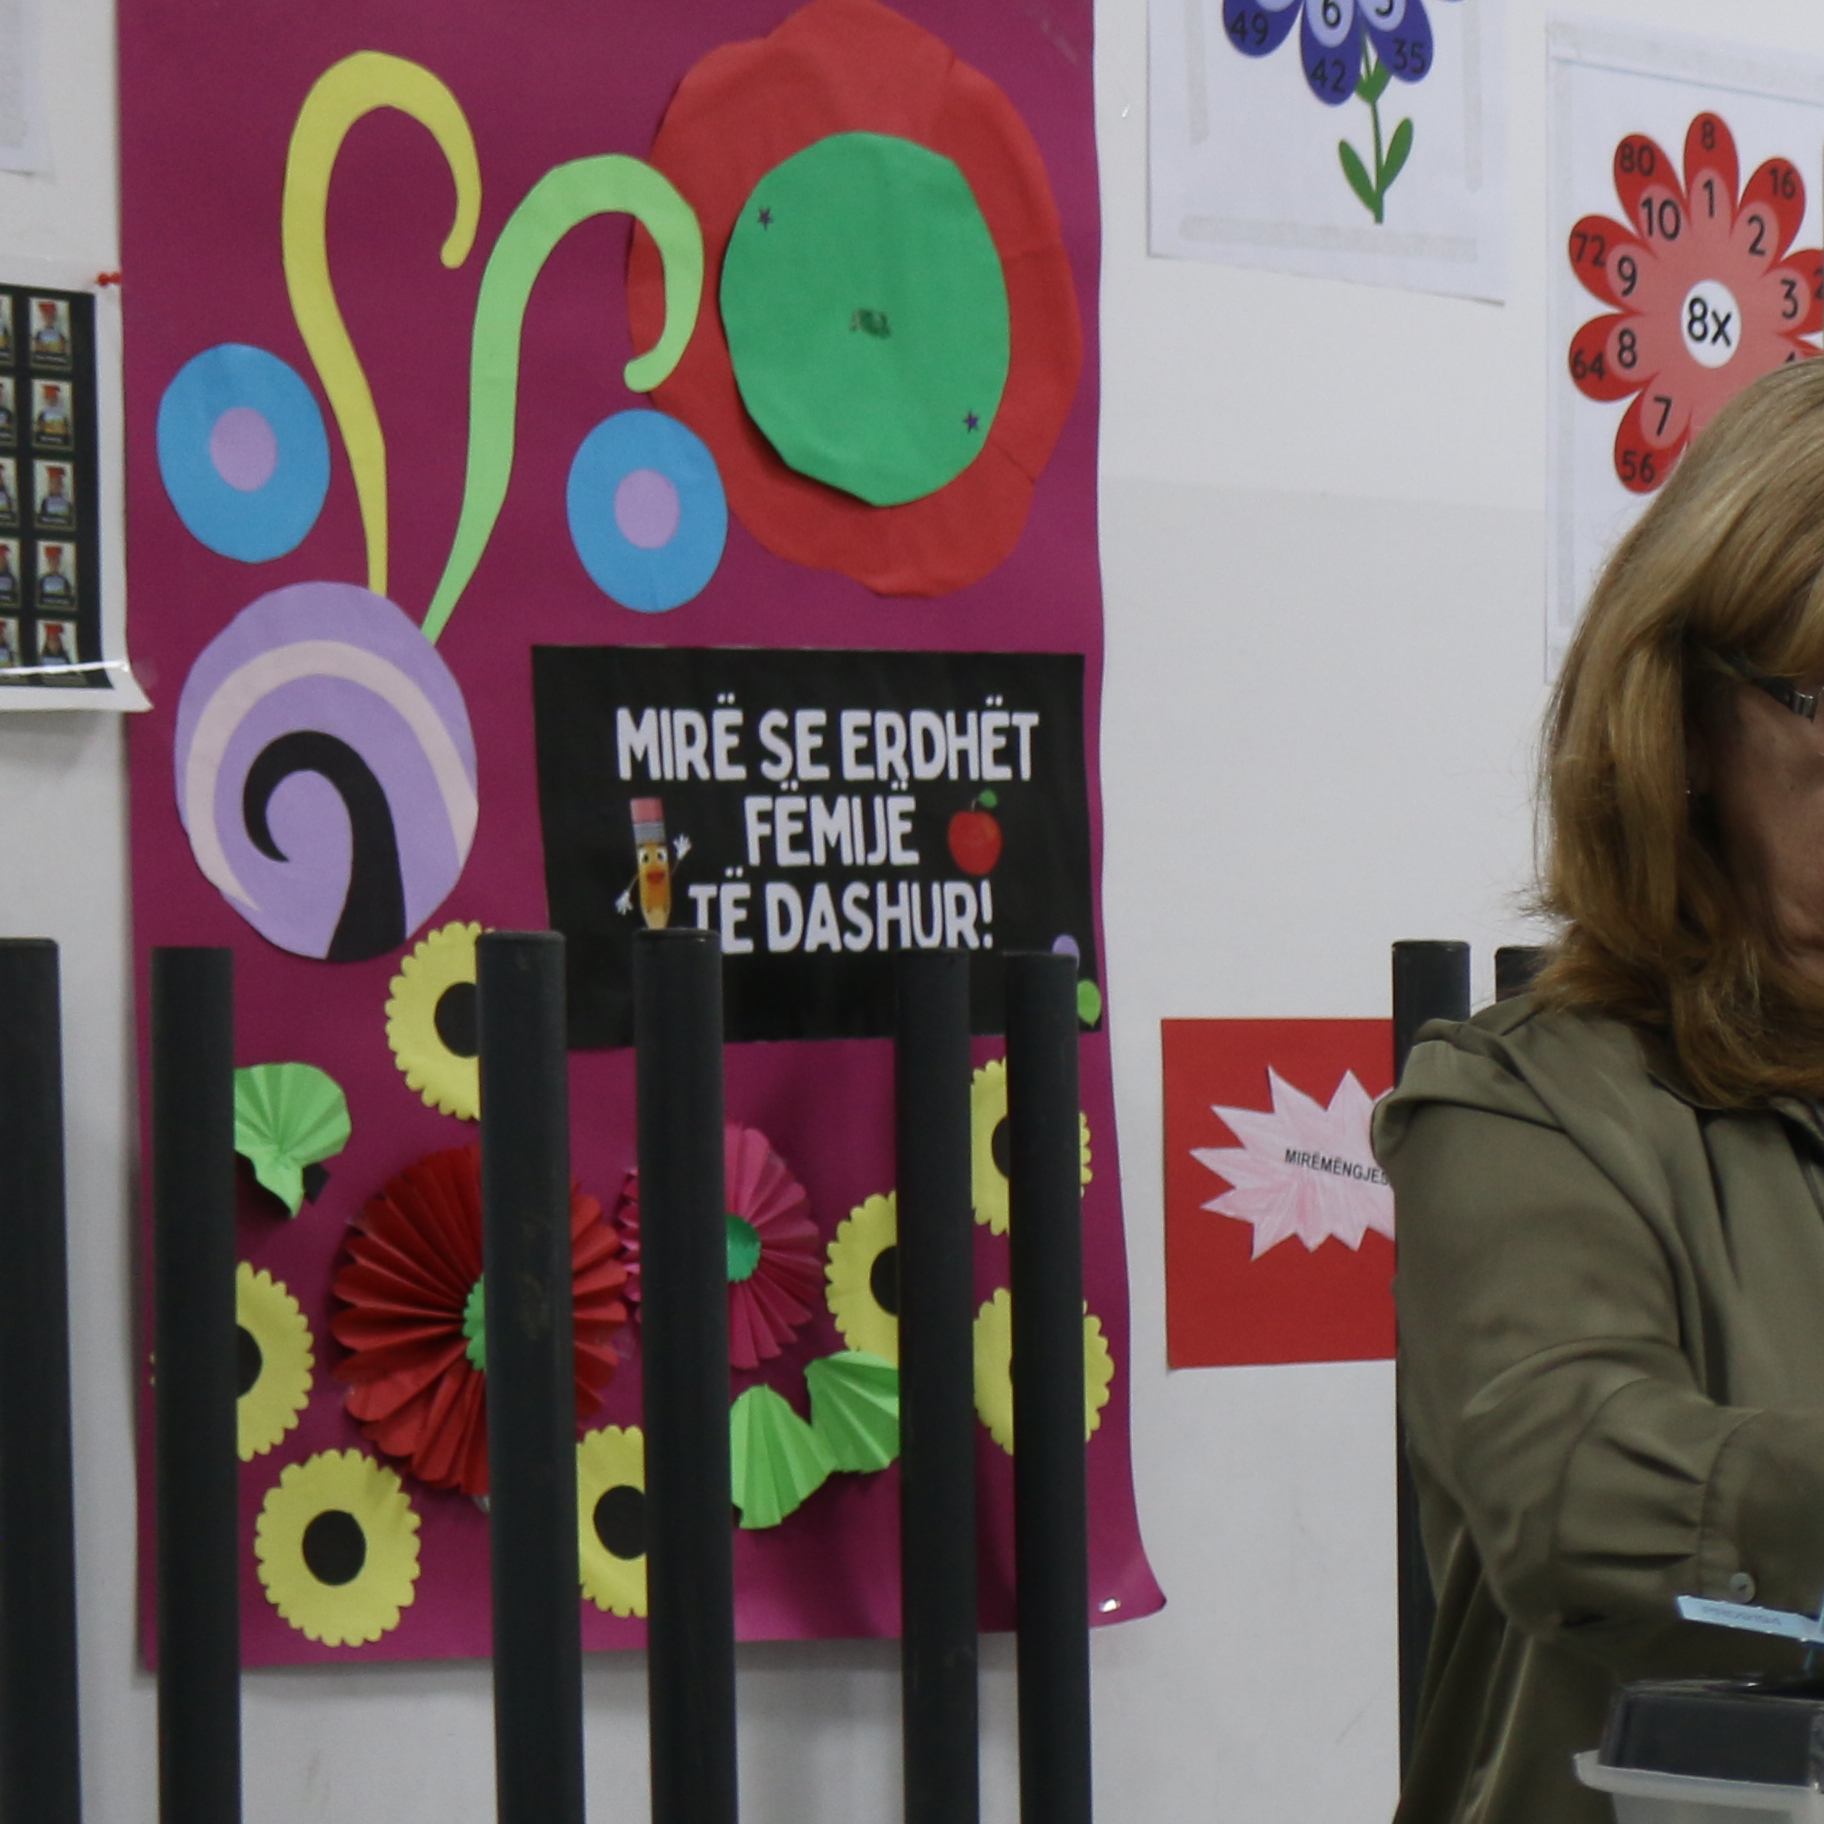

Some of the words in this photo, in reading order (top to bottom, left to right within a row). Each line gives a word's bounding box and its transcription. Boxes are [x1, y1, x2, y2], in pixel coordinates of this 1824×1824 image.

[1228, 12, 1270, 46] 49
[1321, 0, 1341, 28] 6
[1309, 57, 1347, 93] 42
[1393, 38, 1426, 74] 35
[1700, 119, 1717, 151] 8
[1618, 143, 1656, 177] 80
[1702, 179, 1715, 218] 1
[1769, 167, 1797, 200] 16
[1640, 196, 1681, 241] 10
[1747, 215, 1766, 257] 2
[1572, 232, 1607, 268] 72
[1616, 255, 1638, 297] 9
[1781, 278, 1799, 319] 3
[1686, 296, 1733, 347] 8x
[1572, 349, 1607, 380] 64
[1617, 328, 1638, 369] 8
[1652, 395, 1673, 437] 7
[1620, 450, 1656, 483] 56
[615, 693, 747, 781] MIRË
[758, 709, 831, 782] SE
[840, 695, 1039, 782] ERDHËT
[744, 779, 920, 867] FËMIJË
[688, 866, 754, 954] TË
[765, 880, 994, 954] DASHUR!
